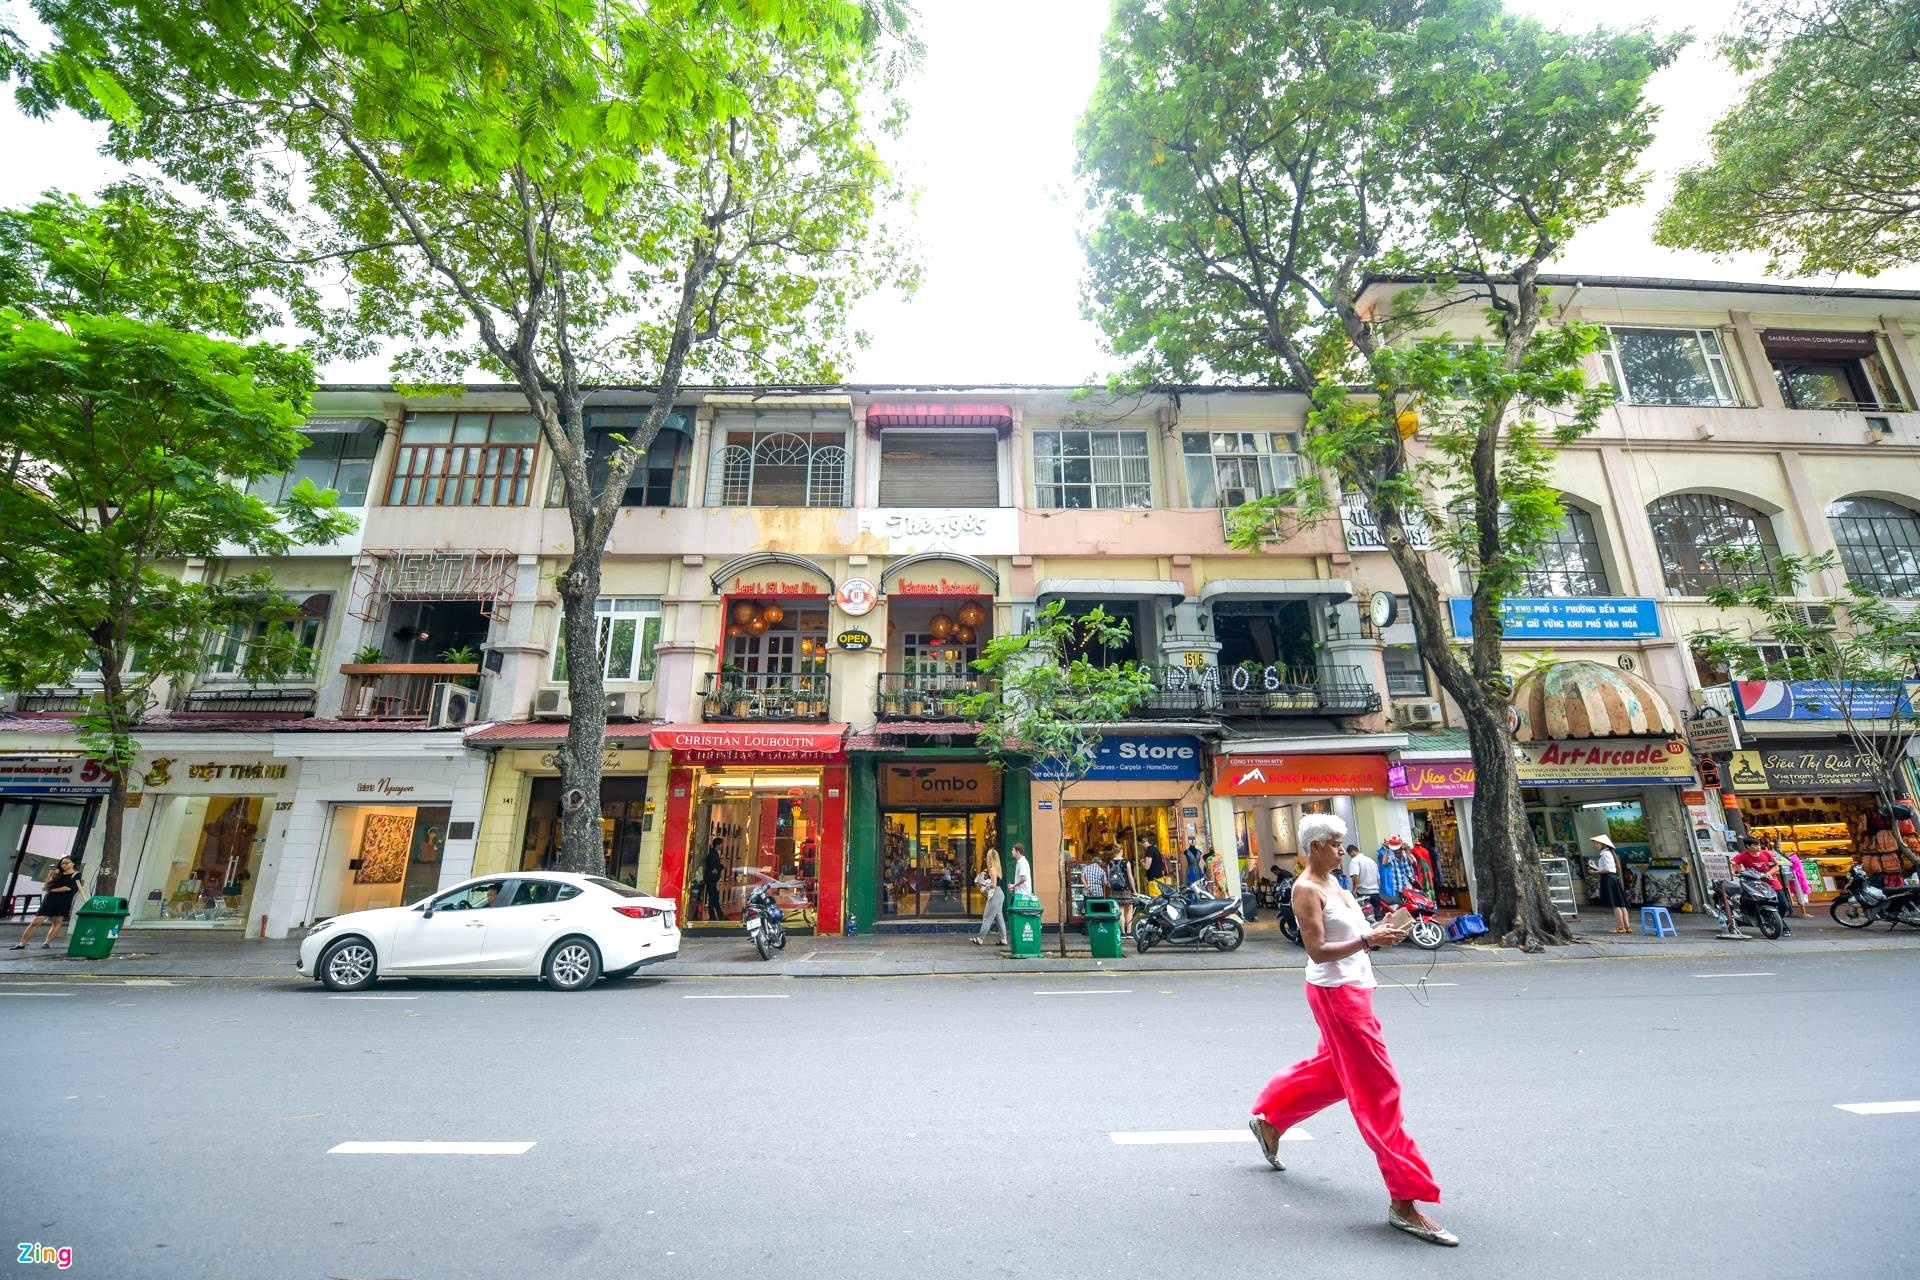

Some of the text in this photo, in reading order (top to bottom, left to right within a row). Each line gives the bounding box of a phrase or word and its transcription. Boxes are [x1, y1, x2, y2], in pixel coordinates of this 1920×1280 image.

[1533, 602, 1550, 614] PHỐ
[1552, 605, 1559, 614] 5
[1599, 603, 1616, 614] BẾN
[1567, 619, 1583, 629] KHU
[1585, 617, 1601, 629] PHỐ
[839, 634, 868, 644] OPEN
[1705, 720, 1723, 728] OLIVE
[1690, 726, 1729, 738] STEAKHOUSE
[675, 734, 815, 747] CHRISTIAN LOUBOUTIN
[1118, 743, 1195, 759] Store
[1538, 743, 1585, 765] Art
[1584, 744, 1669, 765] Arcade
[1119, 764, 1141, 772] Carpets
[1764, 755, 1794, 769] Siêu
[1798, 754, 1821, 771] Thị
[1824, 754, 1851, 771] Quà
[188, 762, 226, 782] VIỆT
[1411, 768, 1446, 792] Nice
[274, 802, 293, 811] 137
